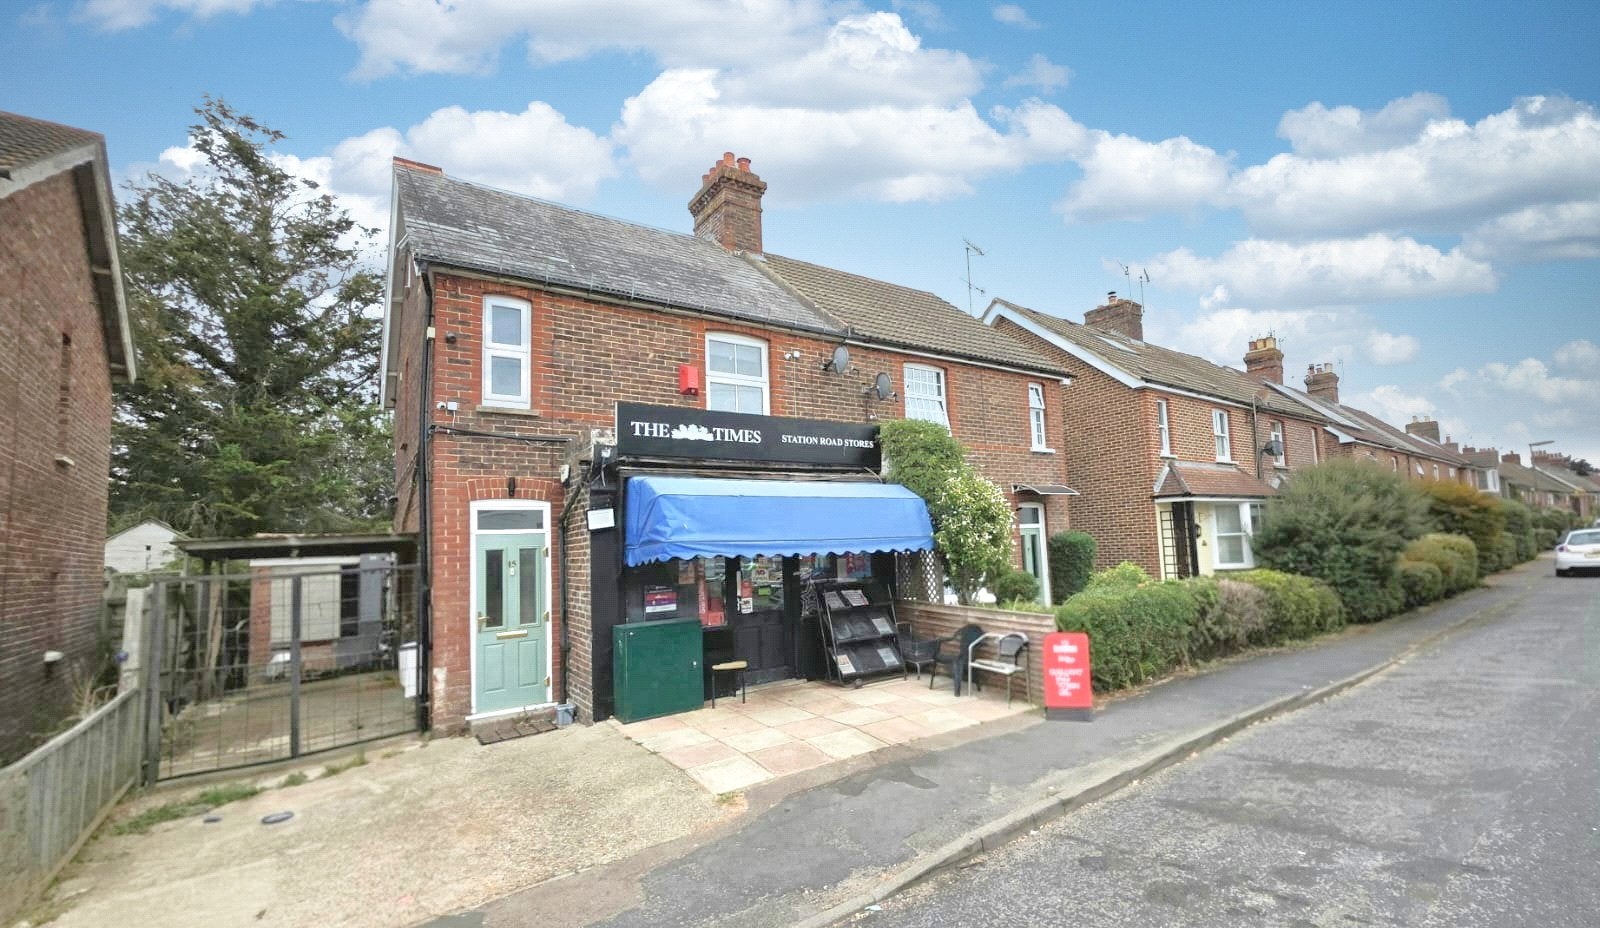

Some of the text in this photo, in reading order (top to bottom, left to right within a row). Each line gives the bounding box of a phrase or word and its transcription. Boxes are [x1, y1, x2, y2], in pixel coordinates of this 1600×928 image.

[630, 421, 761, 443] THE TIMES
[781, 434, 874, 449] STATION ROAD STORES
